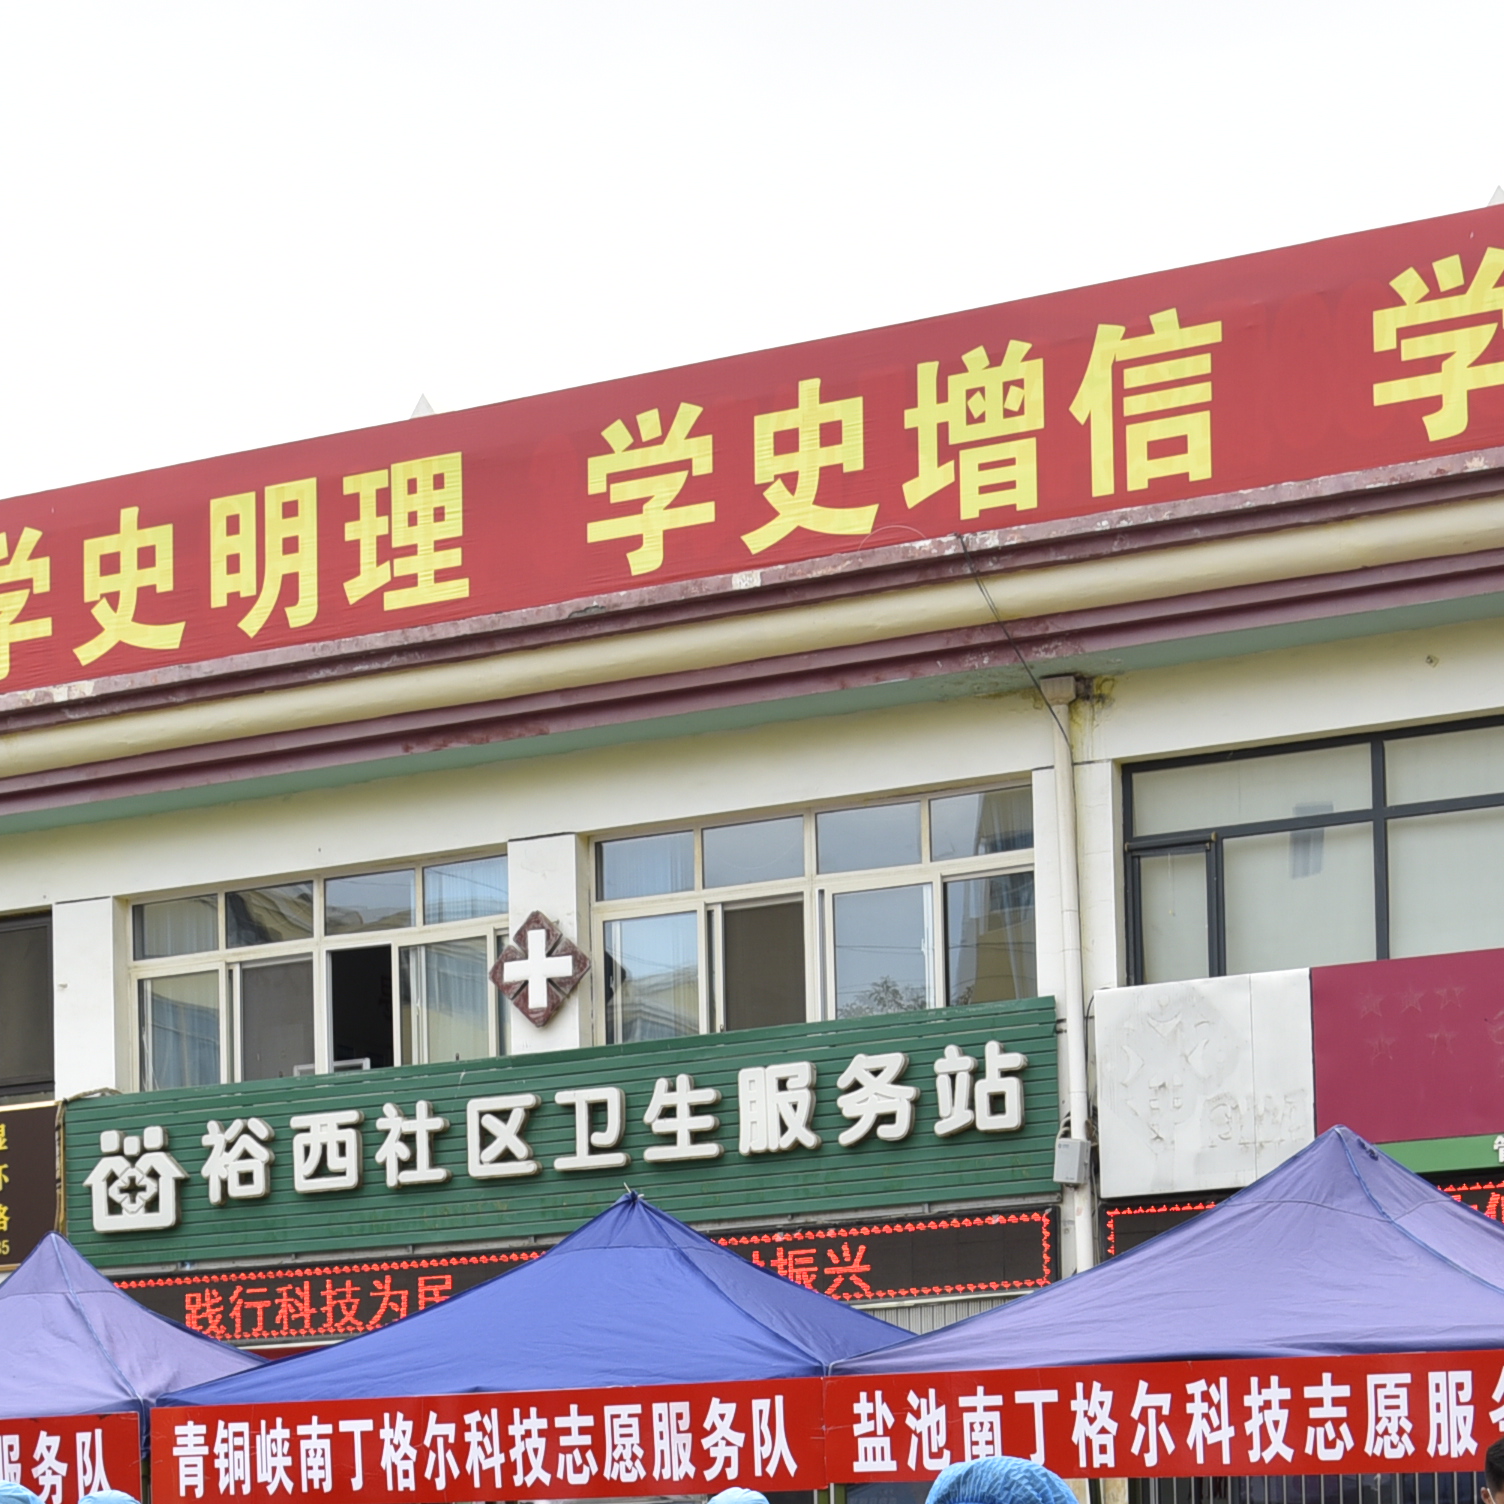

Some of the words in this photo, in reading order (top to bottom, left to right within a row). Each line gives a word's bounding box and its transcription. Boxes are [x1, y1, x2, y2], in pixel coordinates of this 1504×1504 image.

[587, 307, 1223, 576] 学史增信
[200, 1038, 1028, 1204] 裕西社区卫生服务站
[752, 1242, 872, 1297] 振兴
[171, 1394, 799, 1499] 青铜峡南丁格尔科技志愿服务队
